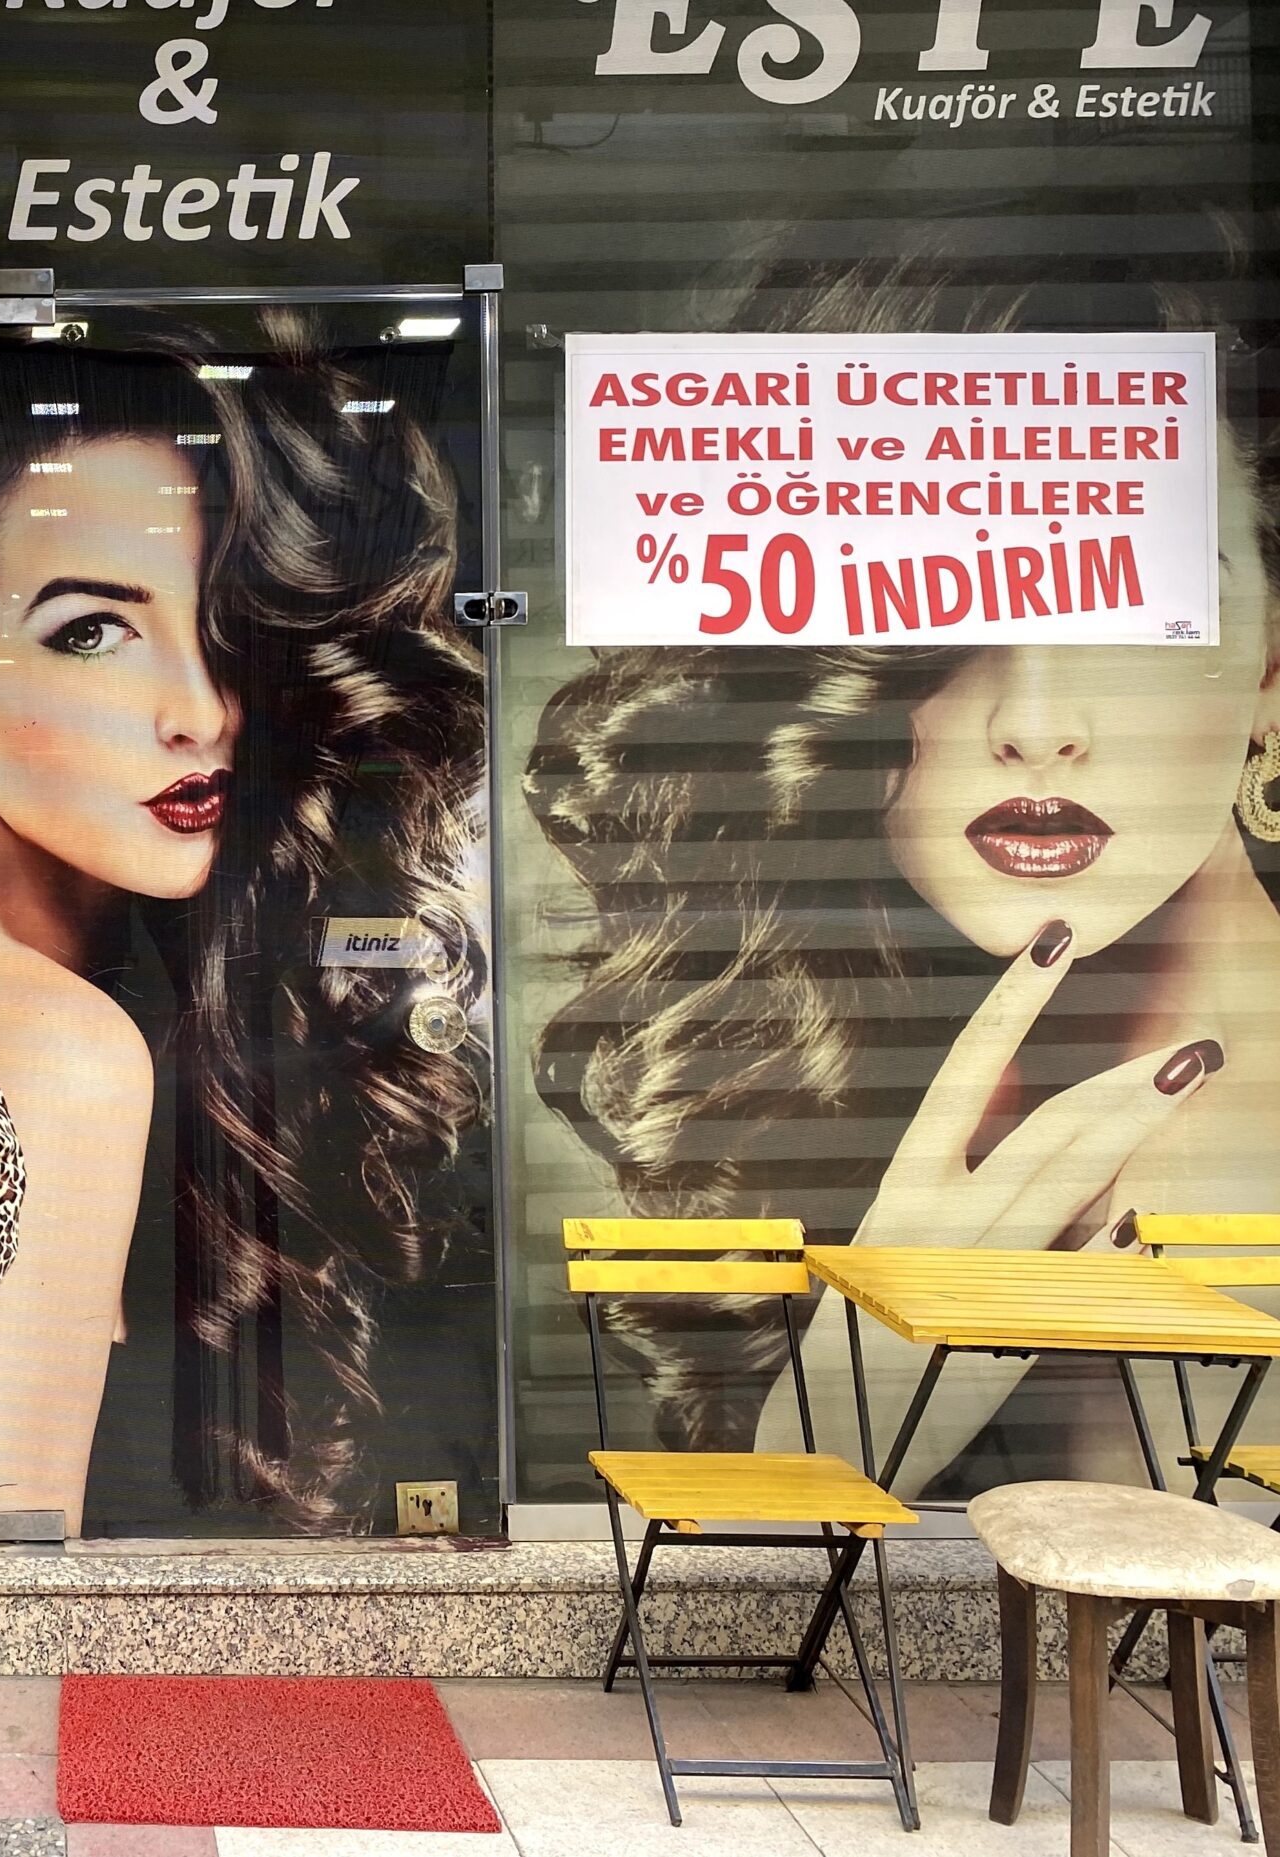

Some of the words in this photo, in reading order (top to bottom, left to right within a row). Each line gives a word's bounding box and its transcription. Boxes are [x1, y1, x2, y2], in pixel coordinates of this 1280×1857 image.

[138, 38, 219, 125] &
[874, 83, 1018, 129] Kuaför
[1027, 83, 1061, 119] &
[1075, 81, 1216, 118] Estetik
[7, 151, 361, 242] Estetik
[589, 362, 810, 407] ASGARİ
[836, 362, 1189, 406] ÜCRETLİLER
[598, 416, 814, 462] EMEKLİ
[837, 437, 905, 461] ve
[925, 416, 1180, 461] AİLELERİ
[636, 492, 705, 517] ve
[726, 471, 1145, 516] ÖĞRENCİLERE
[840, 520, 1144, 636] İNDİRİM
[344, 933, 401, 953] itiniz
